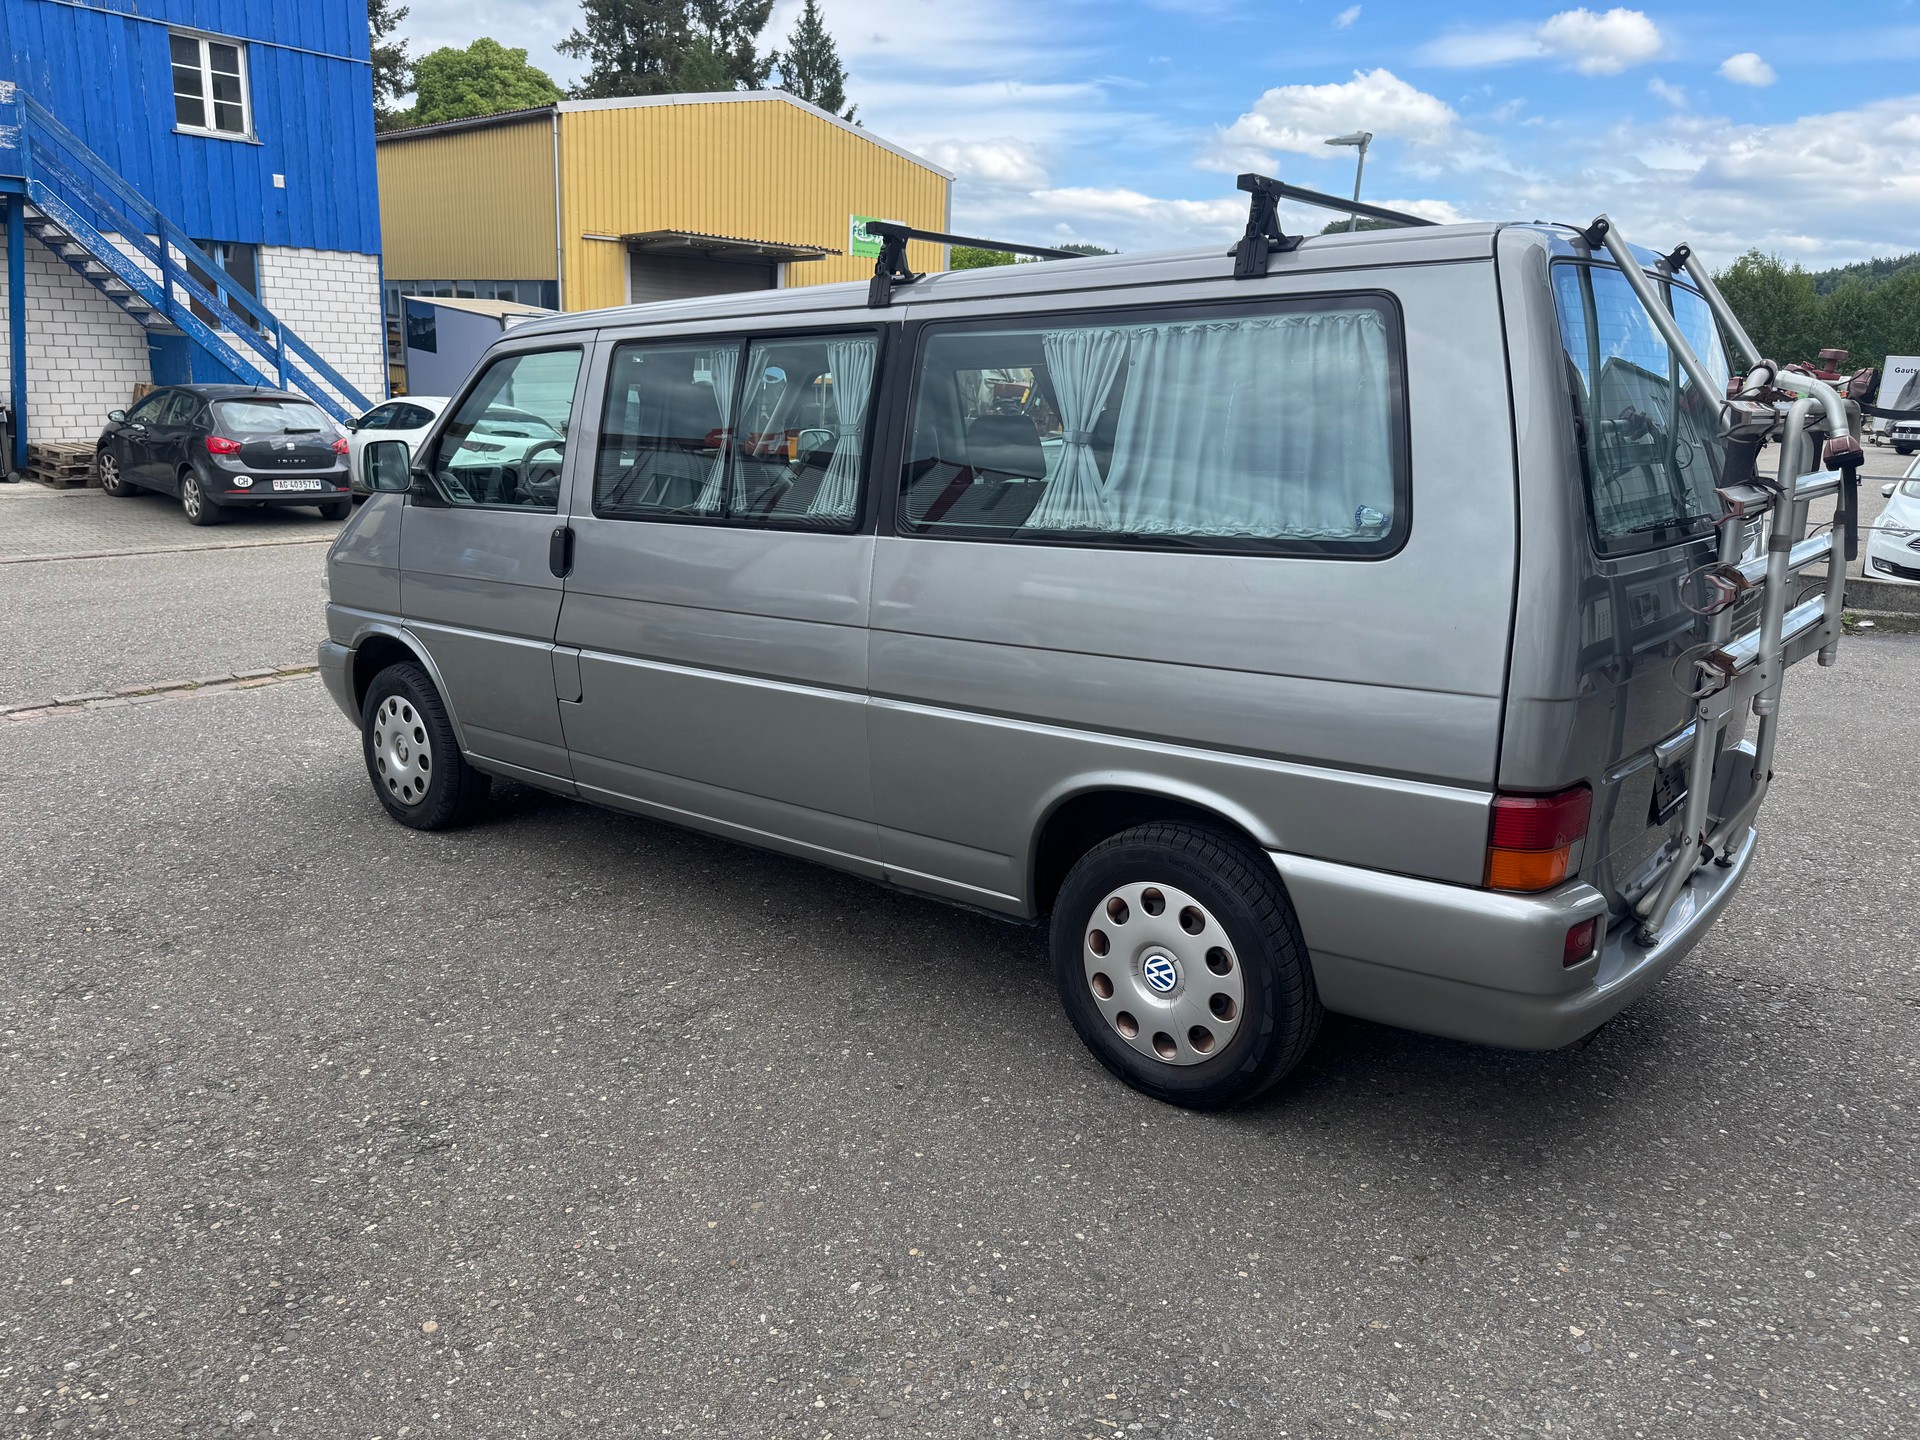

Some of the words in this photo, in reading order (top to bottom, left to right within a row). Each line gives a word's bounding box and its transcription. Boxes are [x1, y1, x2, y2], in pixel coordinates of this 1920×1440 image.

[238, 477, 249, 486] CH
[1168, 855, 1212, 884] VanContact
[1210, 879, 1234, 906] Winter
